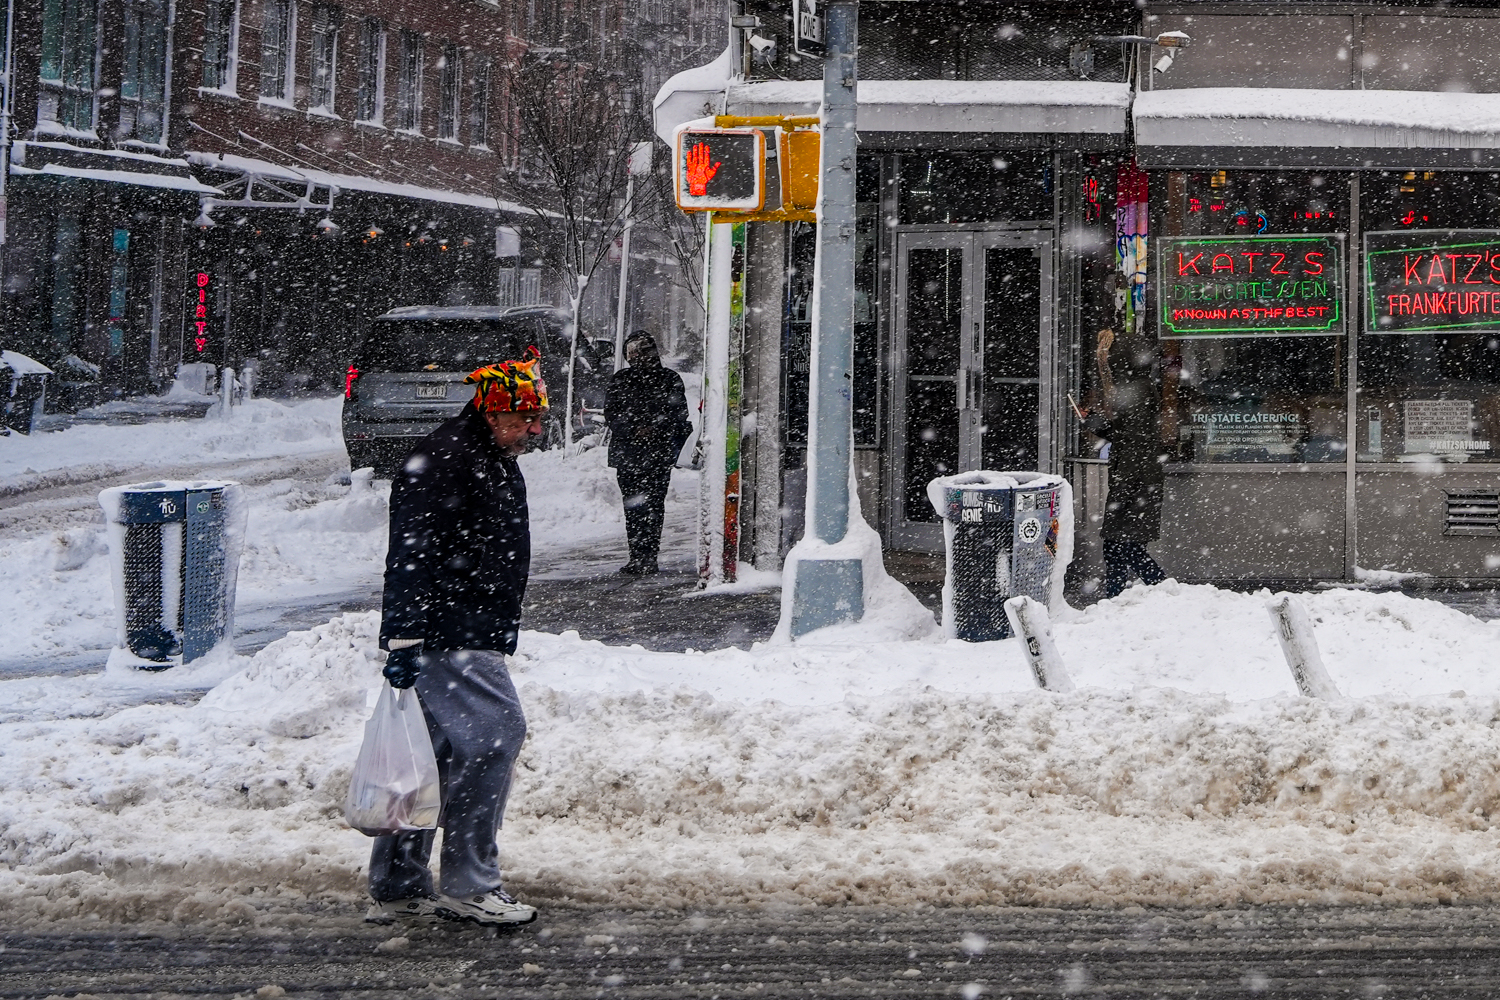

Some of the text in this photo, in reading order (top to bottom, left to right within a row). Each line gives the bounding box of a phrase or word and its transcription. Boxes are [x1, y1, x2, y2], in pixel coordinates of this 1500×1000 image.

[803, 15, 816, 39] ONE
[1174, 280, 1327, 300] DELICATESSEN
[194, 273, 209, 352] DIRTY
[1174, 308, 1227, 320] KNOWN
[1229, 308, 1250, 319] AS
[1285, 306, 1329, 318] BEST
[1192, 413, 1241, 423] TRI-STATE
